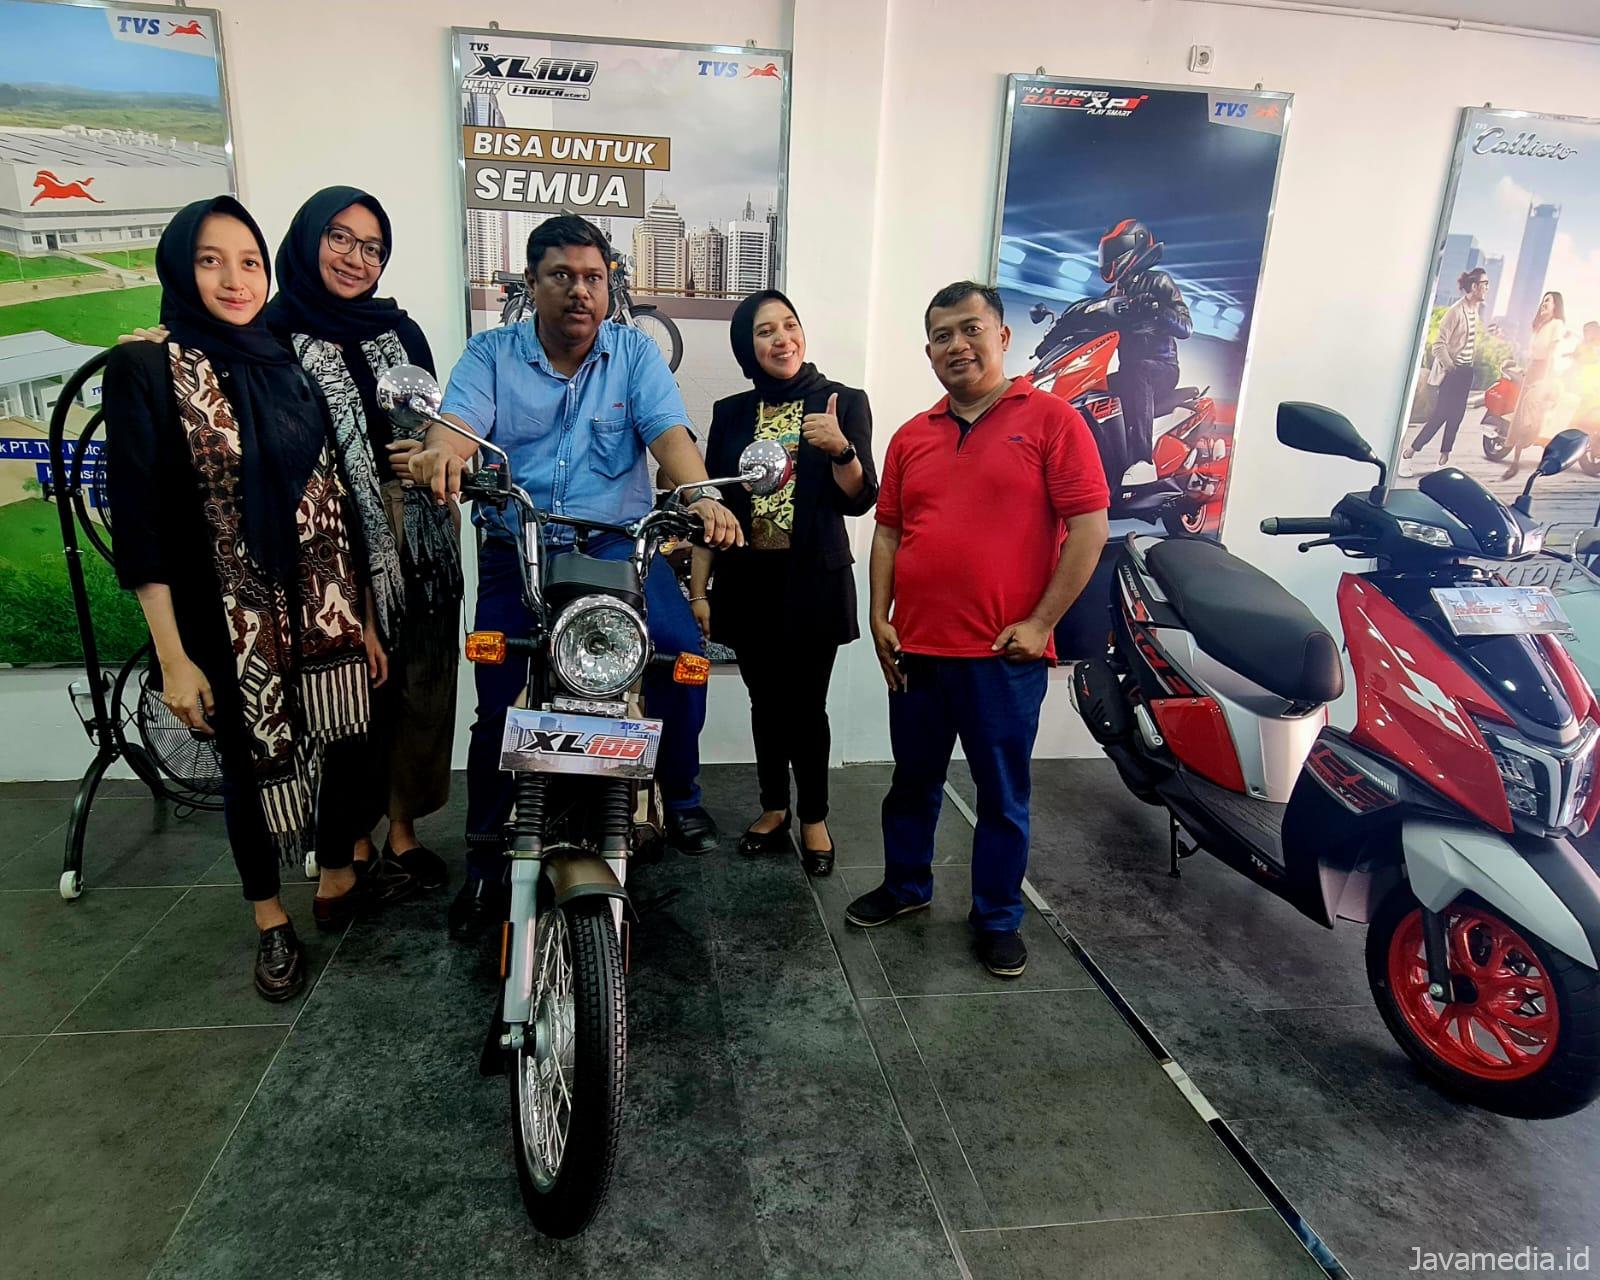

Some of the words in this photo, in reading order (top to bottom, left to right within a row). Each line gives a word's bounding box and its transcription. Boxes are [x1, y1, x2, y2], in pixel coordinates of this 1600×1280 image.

[117, 15, 161, 35] TVS
[468, 42, 490, 52] TVS
[697, 60, 739, 78] TVS
[1022, 94, 1085, 107] RACE
[1106, 109, 1133, 117] SMART
[1214, 102, 1248, 117] TVS
[473, 131, 544, 159] BISA
[550, 135, 657, 165] UNTUK
[1472, 127, 1578, 160] Callisto
[474, 167, 630, 209] SEMUA
[9, 441, 32, 454] PT.
[619, 721, 641, 731] TVS
